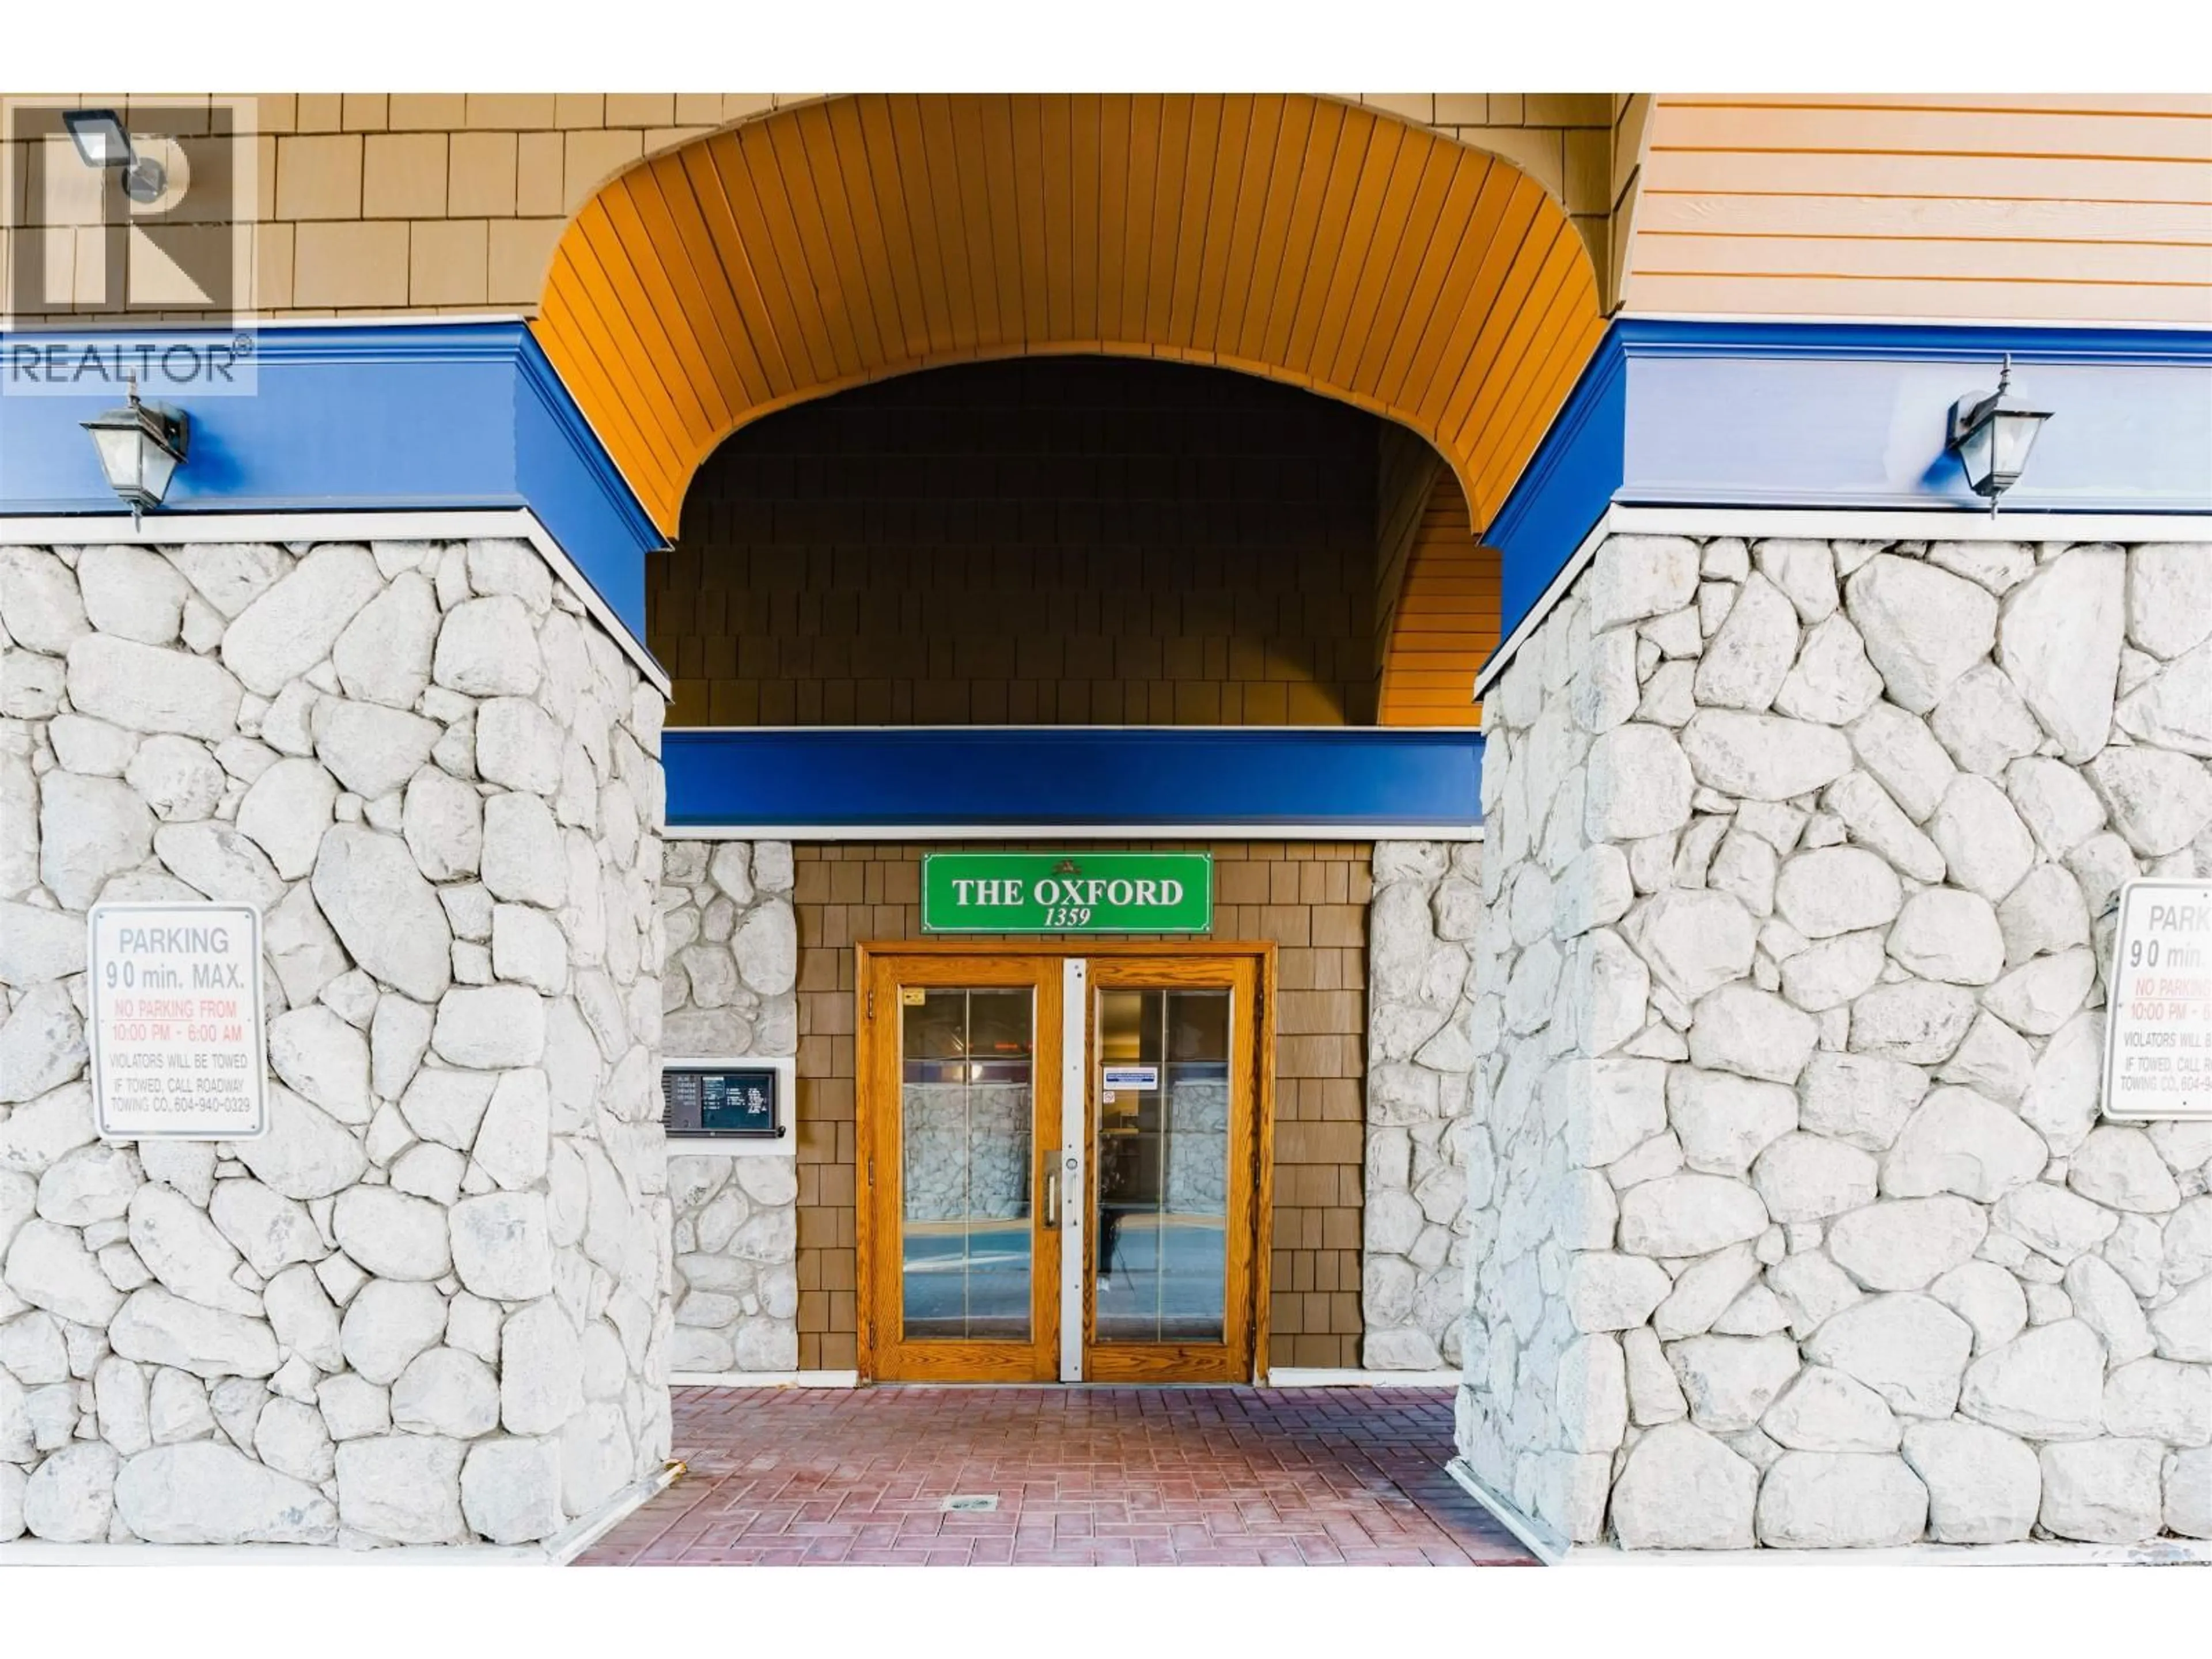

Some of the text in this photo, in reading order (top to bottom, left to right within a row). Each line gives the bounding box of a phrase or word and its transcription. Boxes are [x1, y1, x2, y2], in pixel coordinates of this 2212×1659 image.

[952, 879, 1184, 906] THE OXFORD
[1044, 908, 1091, 926] 1359
[119, 927, 229, 954] PARKING
[142, 963, 183, 988] min.
[192, 963, 244, 988] MAX.
[2136, 977, 2154, 996] NO
[115, 999, 237, 1018] NO PARKING FROM
[2131, 1002, 2164, 1020] 10:00
[2169, 1002, 2187, 1020] PM
[112, 1024, 146, 1041] 10:00
[151, 1024, 171, 1041] PM
[187, 1024, 217, 1042] 6:00
[223, 1025, 243, 1041] AM
[2124, 1032, 2176, 1047] VIOLATORS
[2180, 1032, 2202, 1047] WILL
[109, 1053, 248, 1069] VIOLATORS WILL BE TOWED
[2125, 1056, 2134, 1071] IF
[2177, 1056, 2200, 1071] CALL
[113, 1078, 122, 1093] IF
[167, 1078, 194, 1093] CALL
[196, 1078, 244, 1093] ROADWAY
[2120, 1075, 2157, 1090] TOWING
[111, 1097, 150, 1112] TOWING
